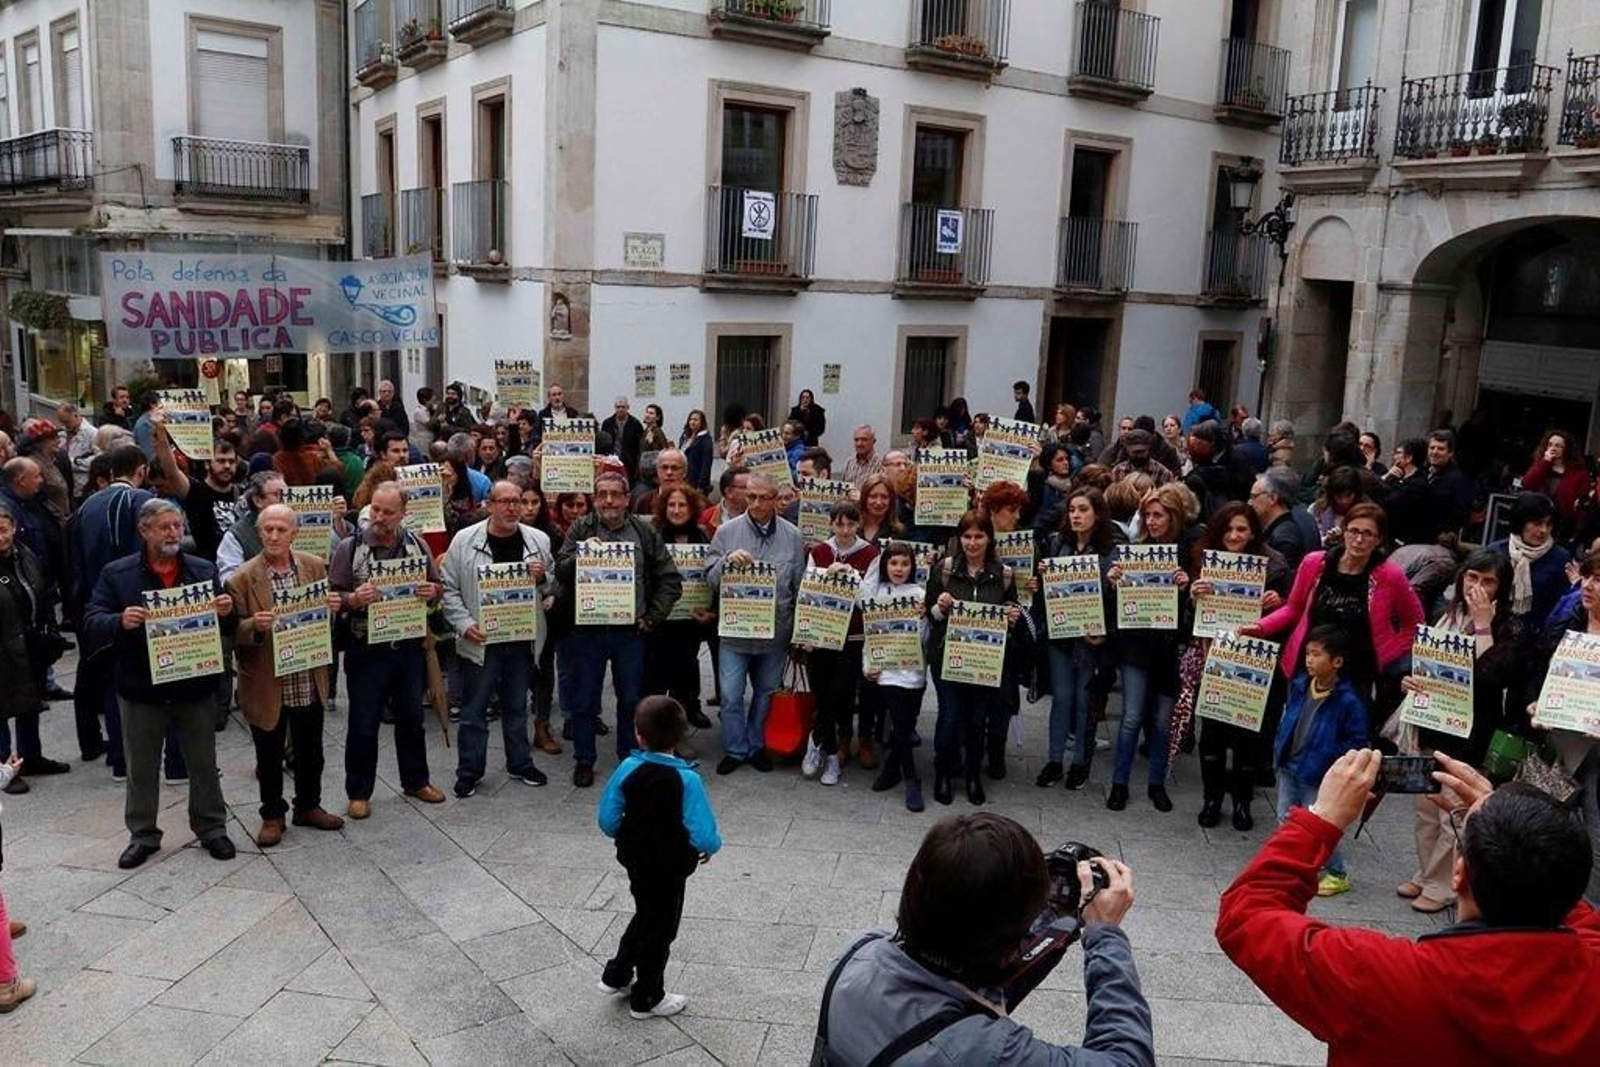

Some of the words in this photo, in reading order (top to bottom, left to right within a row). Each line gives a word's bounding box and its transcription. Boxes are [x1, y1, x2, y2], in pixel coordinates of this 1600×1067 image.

[112, 260, 154, 281] Pola
[172, 260, 249, 281] defensa
[262, 261, 287, 282] da
[373, 285, 427, 299] VECINAL
[121, 288, 314, 328] SANIDADE
[328, 328, 383, 346] CASCO
[392, 326, 437, 343] VELLO
